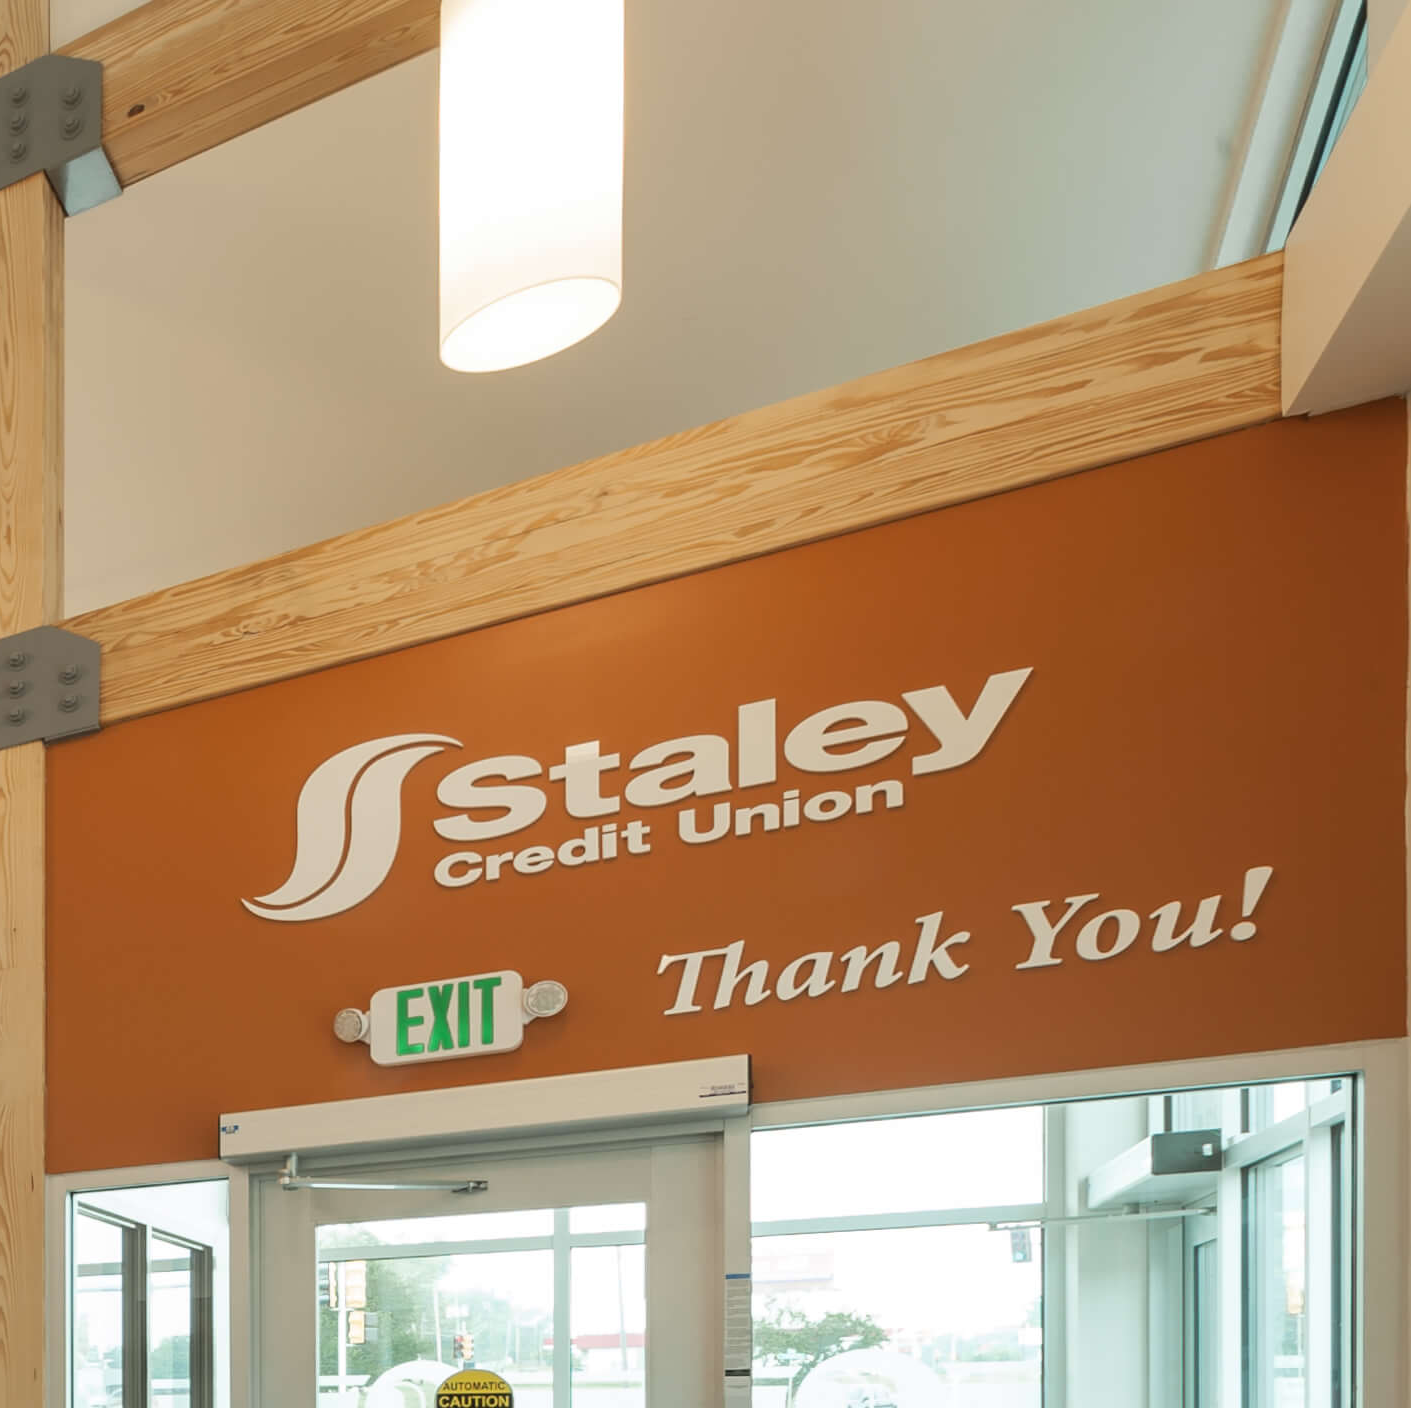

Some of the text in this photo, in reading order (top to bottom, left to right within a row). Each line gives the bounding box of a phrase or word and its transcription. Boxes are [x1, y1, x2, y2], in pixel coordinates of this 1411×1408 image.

[432, 666, 1034, 842] Staley
[433, 779, 905, 889] Credit Union
[655, 865, 1274, 1017] Thank You!
[396, 975, 503, 1057] EXIT
[438, 1394, 510, 1408] CAUTION
[442, 1381, 507, 1392] AUTOMATIC
